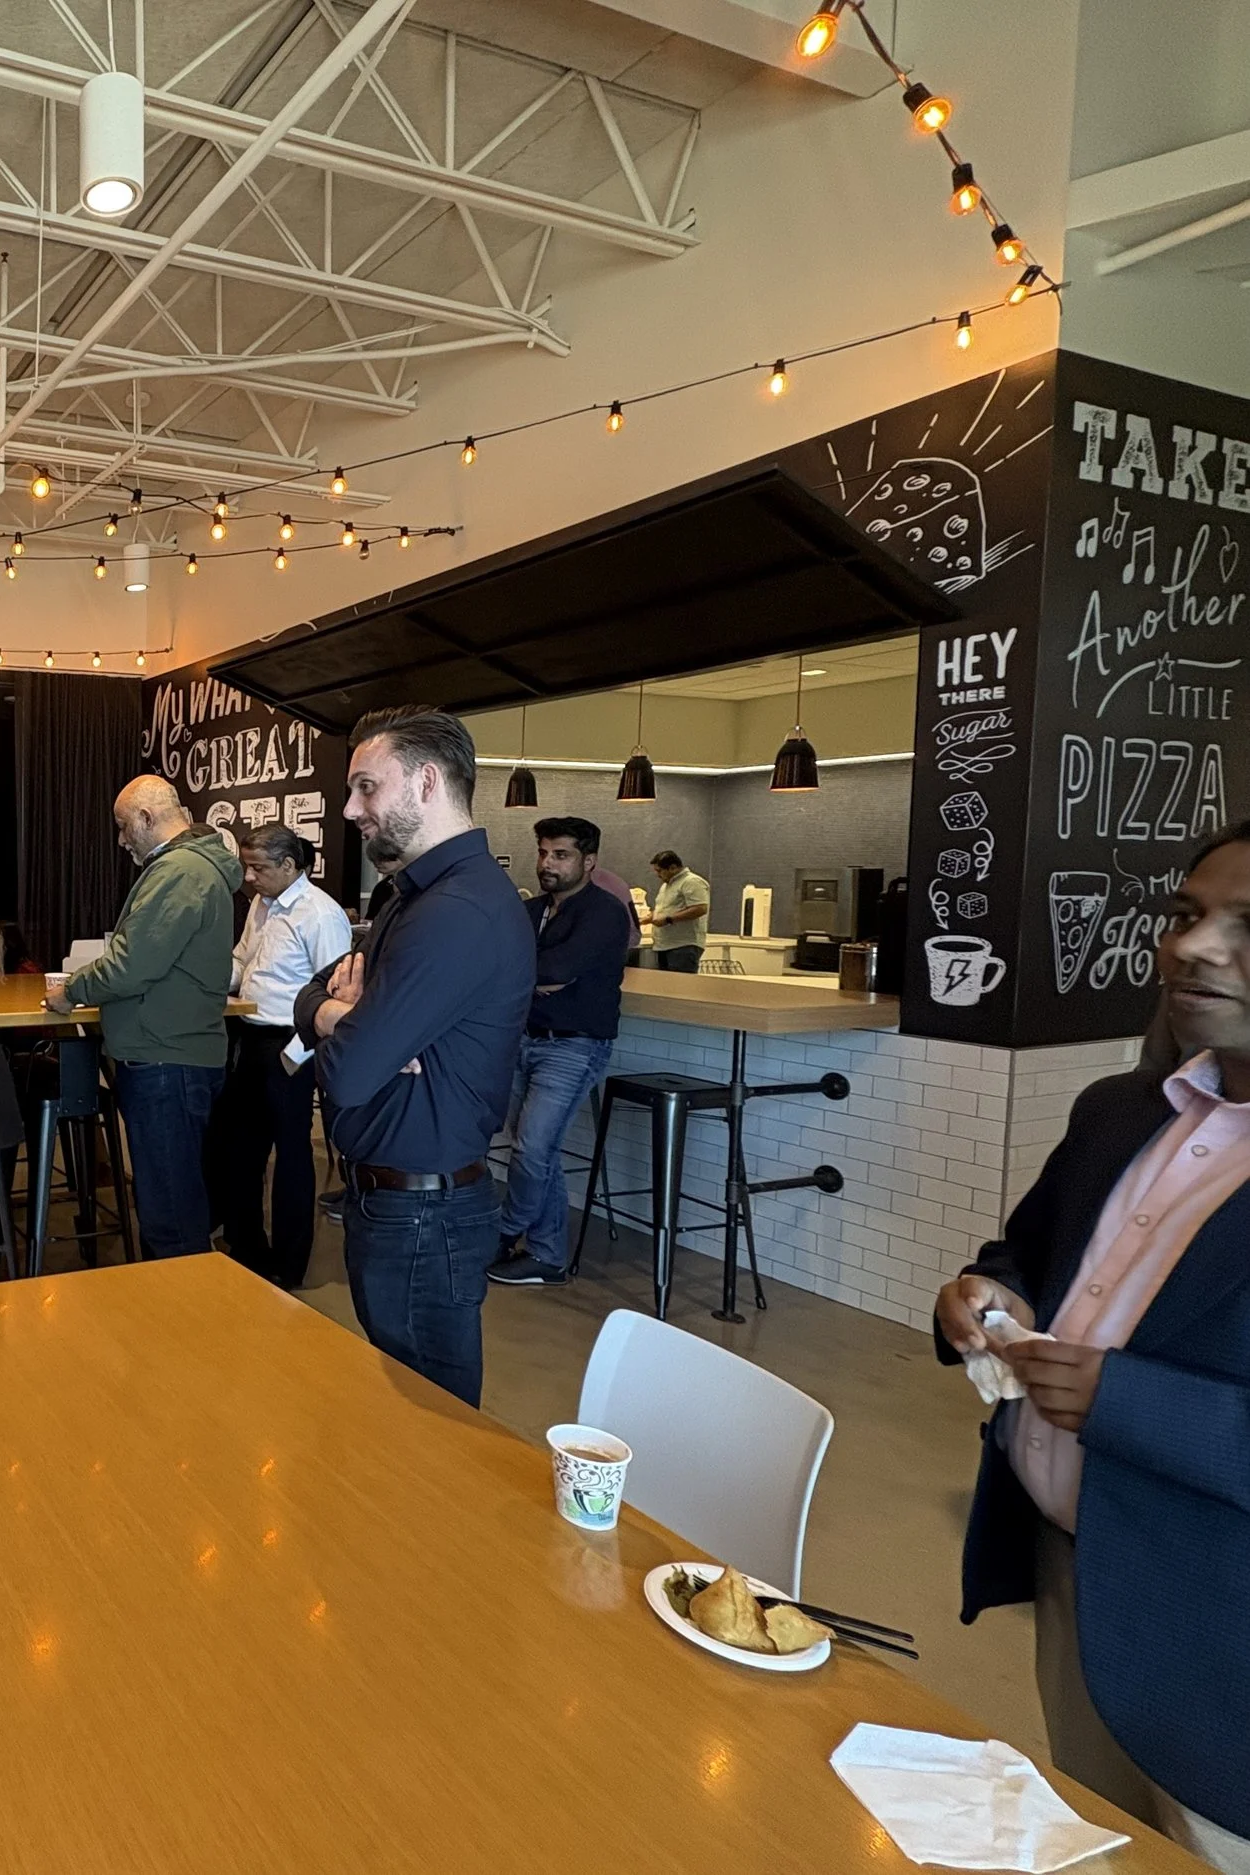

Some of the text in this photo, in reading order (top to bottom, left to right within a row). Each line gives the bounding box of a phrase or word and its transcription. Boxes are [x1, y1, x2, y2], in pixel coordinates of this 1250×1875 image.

[1073, 401, 1250, 513] TAKE
[1067, 524, 1246, 709] Another
[937, 627, 1018, 688] HEY
[141, 681, 186, 780] My
[936, 711, 1013, 746] Sugar
[938, 685, 1007, 706] THERE
[1147, 680, 1234, 720] LITTLE
[186, 719, 322, 793] GREAT
[1058, 733, 1227, 841] PIZZA
